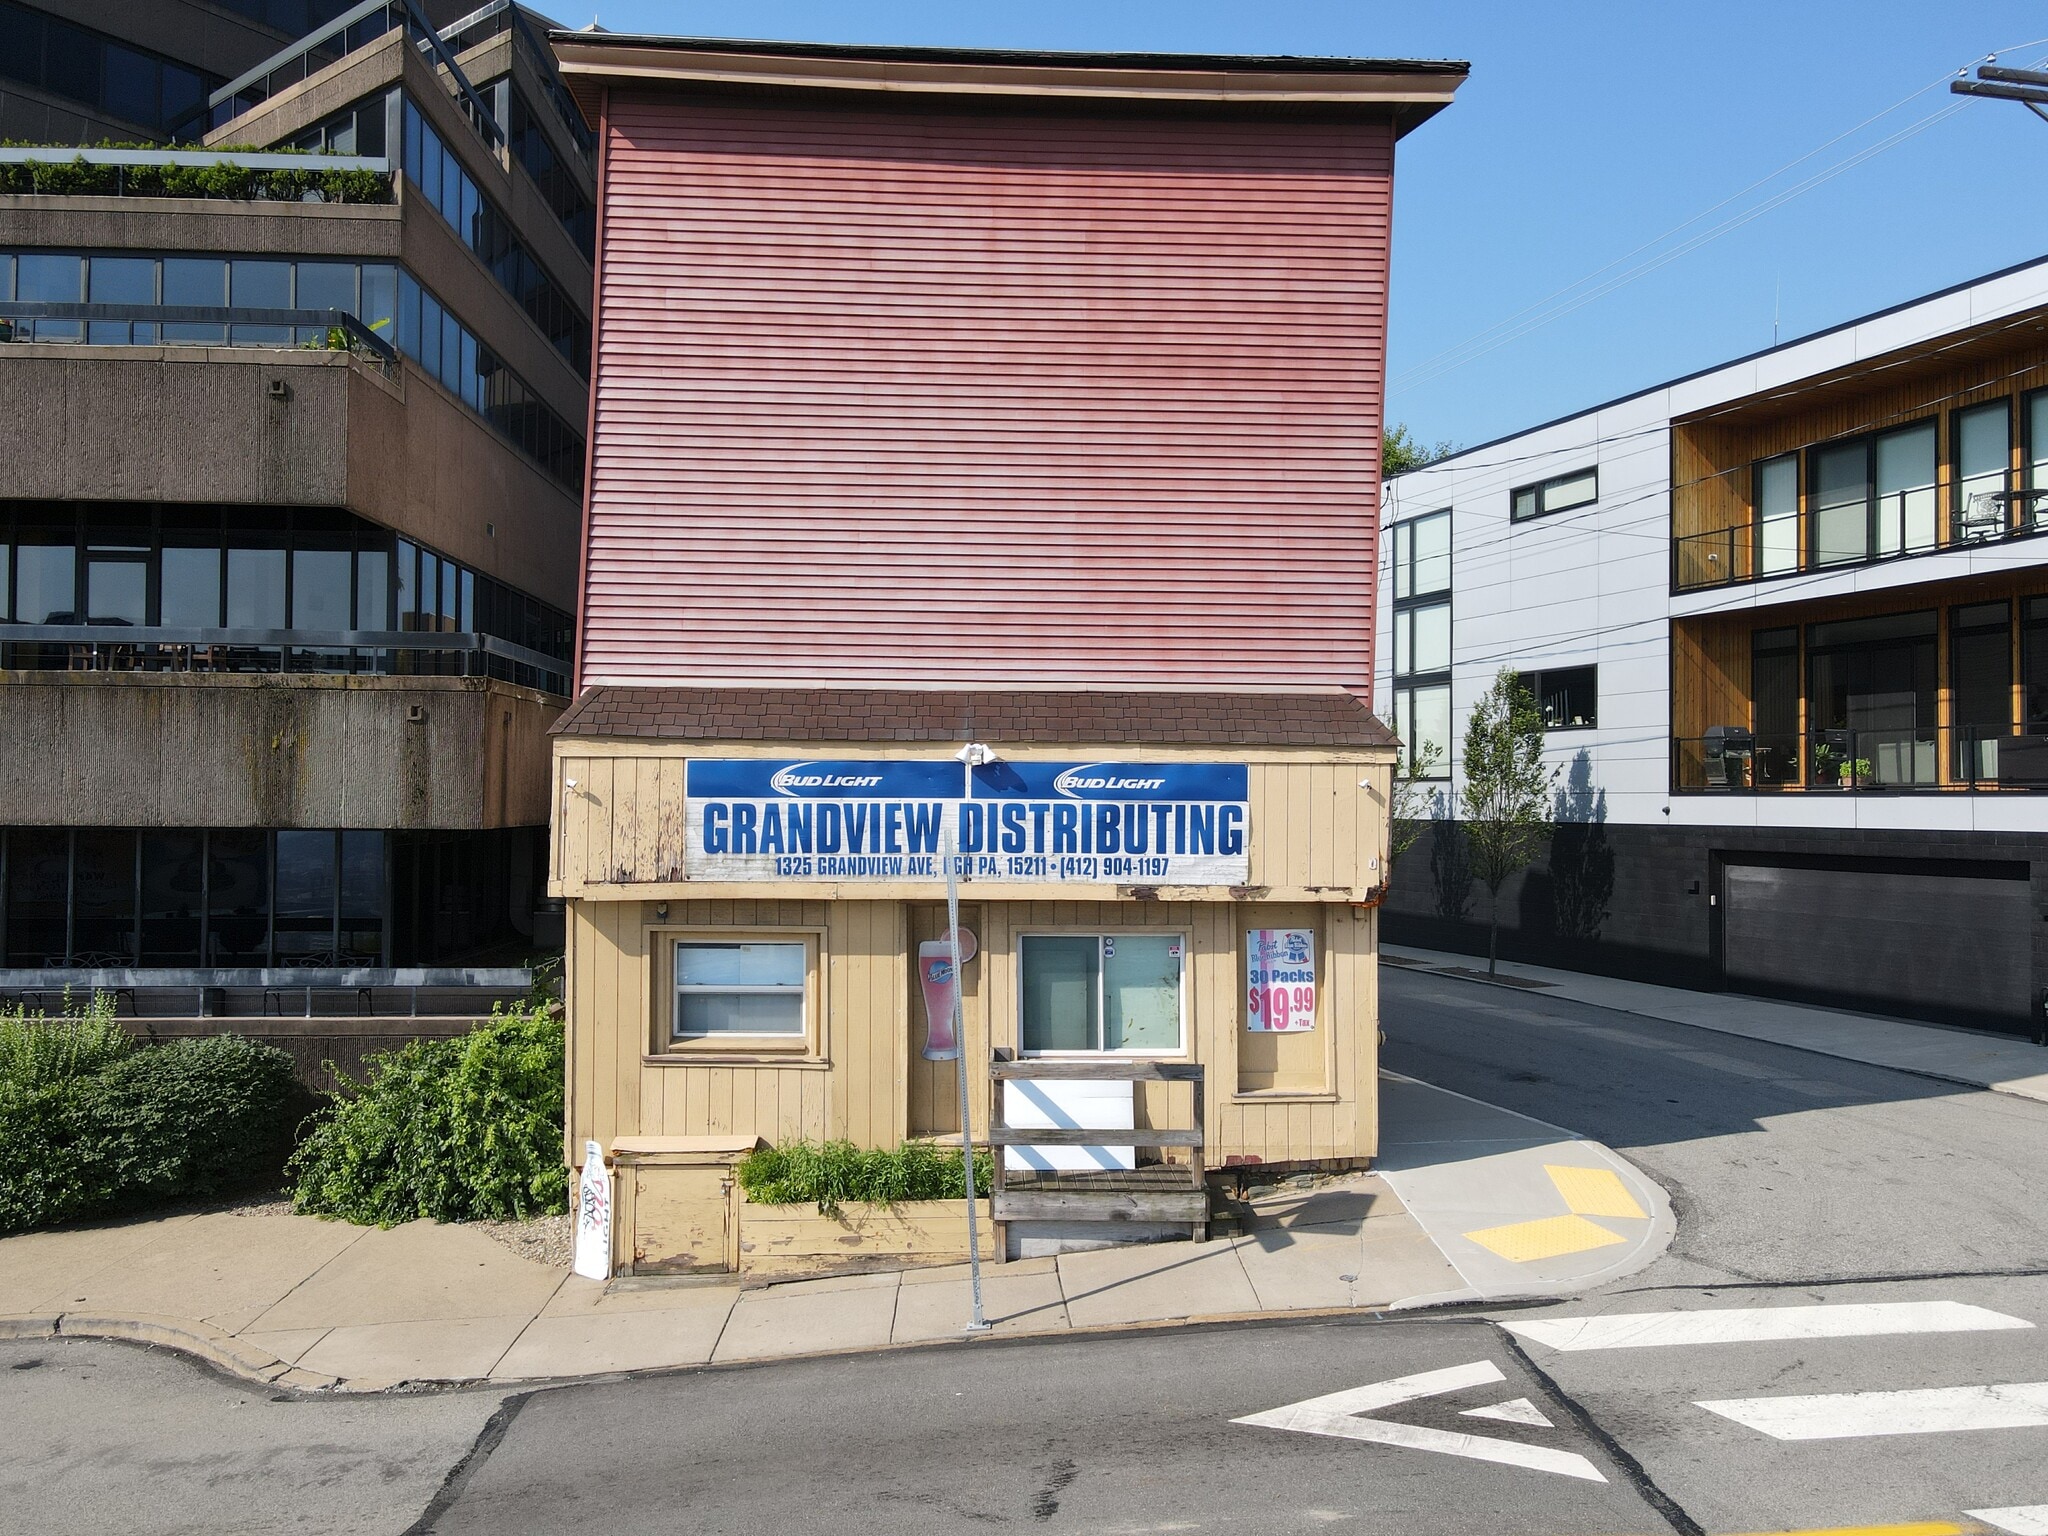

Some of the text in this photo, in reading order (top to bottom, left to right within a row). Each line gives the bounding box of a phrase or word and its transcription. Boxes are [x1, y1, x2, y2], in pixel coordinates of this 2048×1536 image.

[703, 803, 1243, 855] GRANDVIEW DISTRIBUTING
[775, 857, 812, 875] 1325
[817, 857, 902, 875] GRANDVIEW
[908, 857, 938, 878] AVE,
[978, 857, 1001, 878] PA,
[1007, 857, 1046, 875] 15211
[1060, 857, 1098, 879] (412)
[1103, 857, 1169, 876] 904-1197
[1250, 969, 1314, 984] 30 Packs
[1249, 986, 1314, 1030] $19.99
